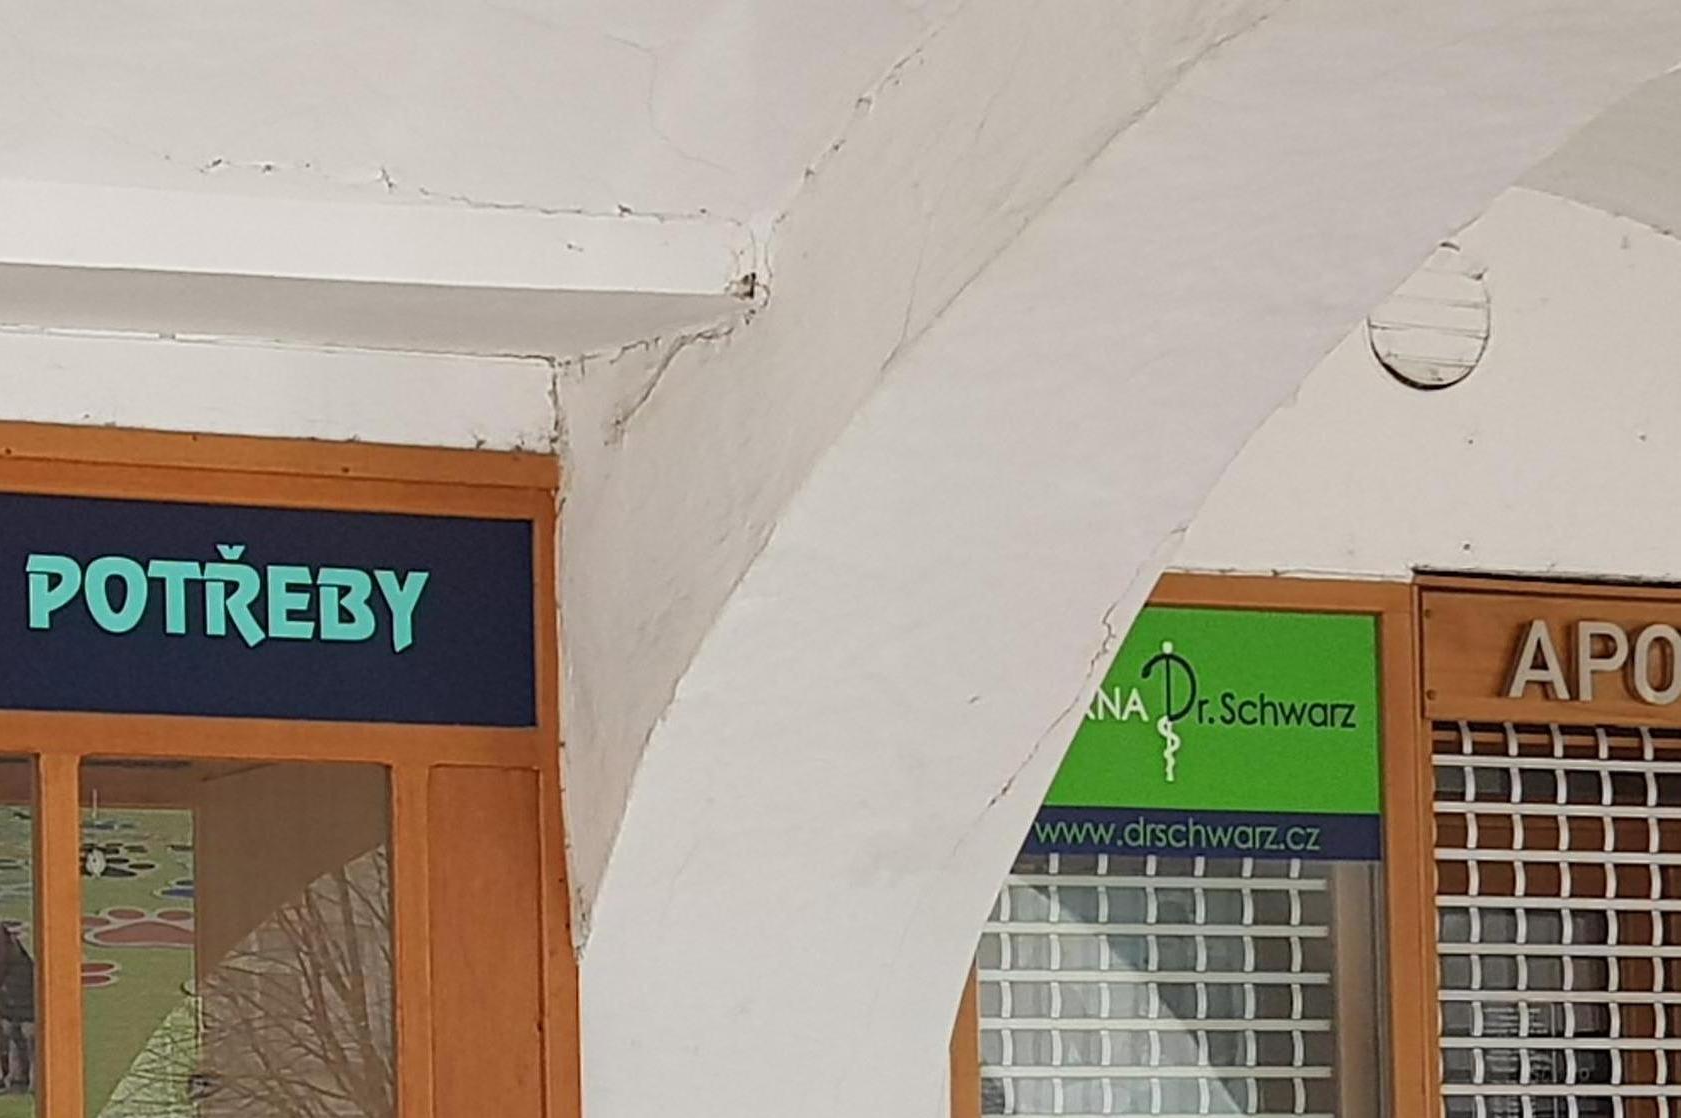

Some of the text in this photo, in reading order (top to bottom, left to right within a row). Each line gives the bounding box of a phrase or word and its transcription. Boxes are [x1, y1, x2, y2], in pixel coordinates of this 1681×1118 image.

[25, 543, 429, 653] POTŘEBY
[1508, 618, 1681, 704] APO
[1086, 687, 1149, 722] NA
[1035, 816, 1320, 850] www.drschwarz.cz
